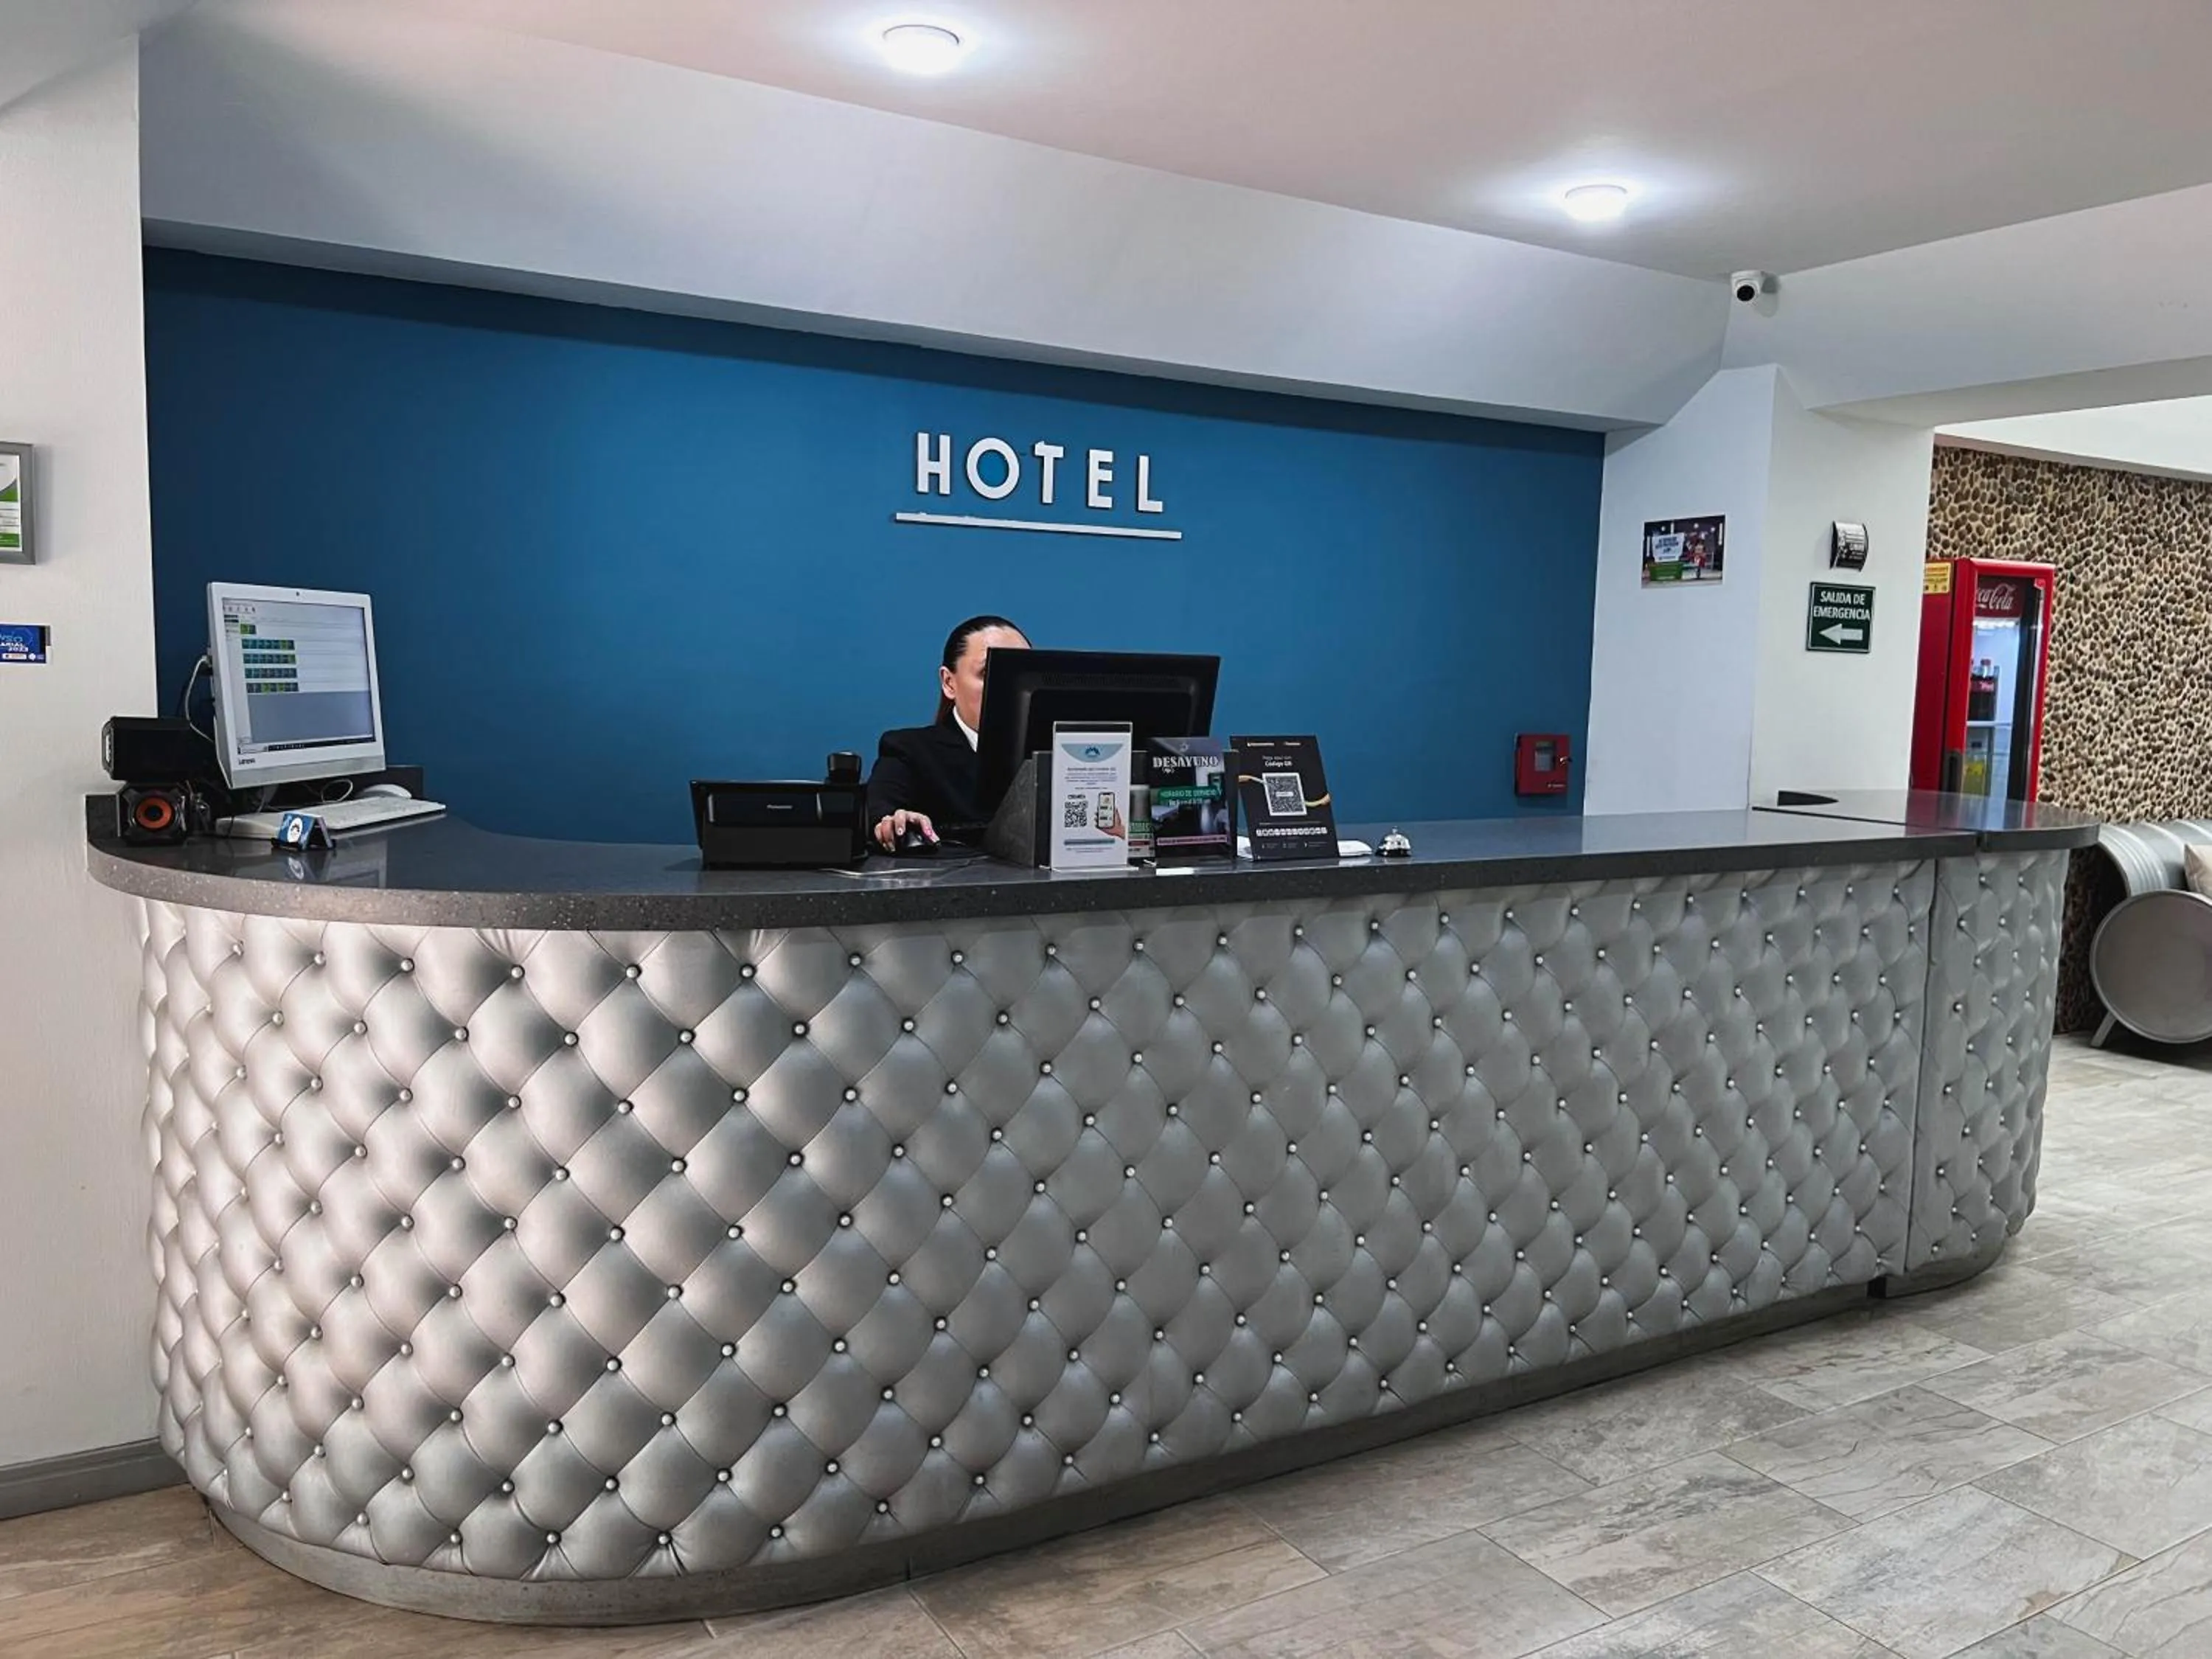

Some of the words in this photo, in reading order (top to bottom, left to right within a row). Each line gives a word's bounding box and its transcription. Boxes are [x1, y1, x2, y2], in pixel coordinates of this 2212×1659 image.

[917, 432, 1164, 513] HOTEL
[1820, 591, 1851, 604] SALIDA
[1853, 594, 1866, 605] DE
[1813, 605, 1871, 620] EMERGENCIA
[1152, 756, 1219, 768] DESAYUNO
